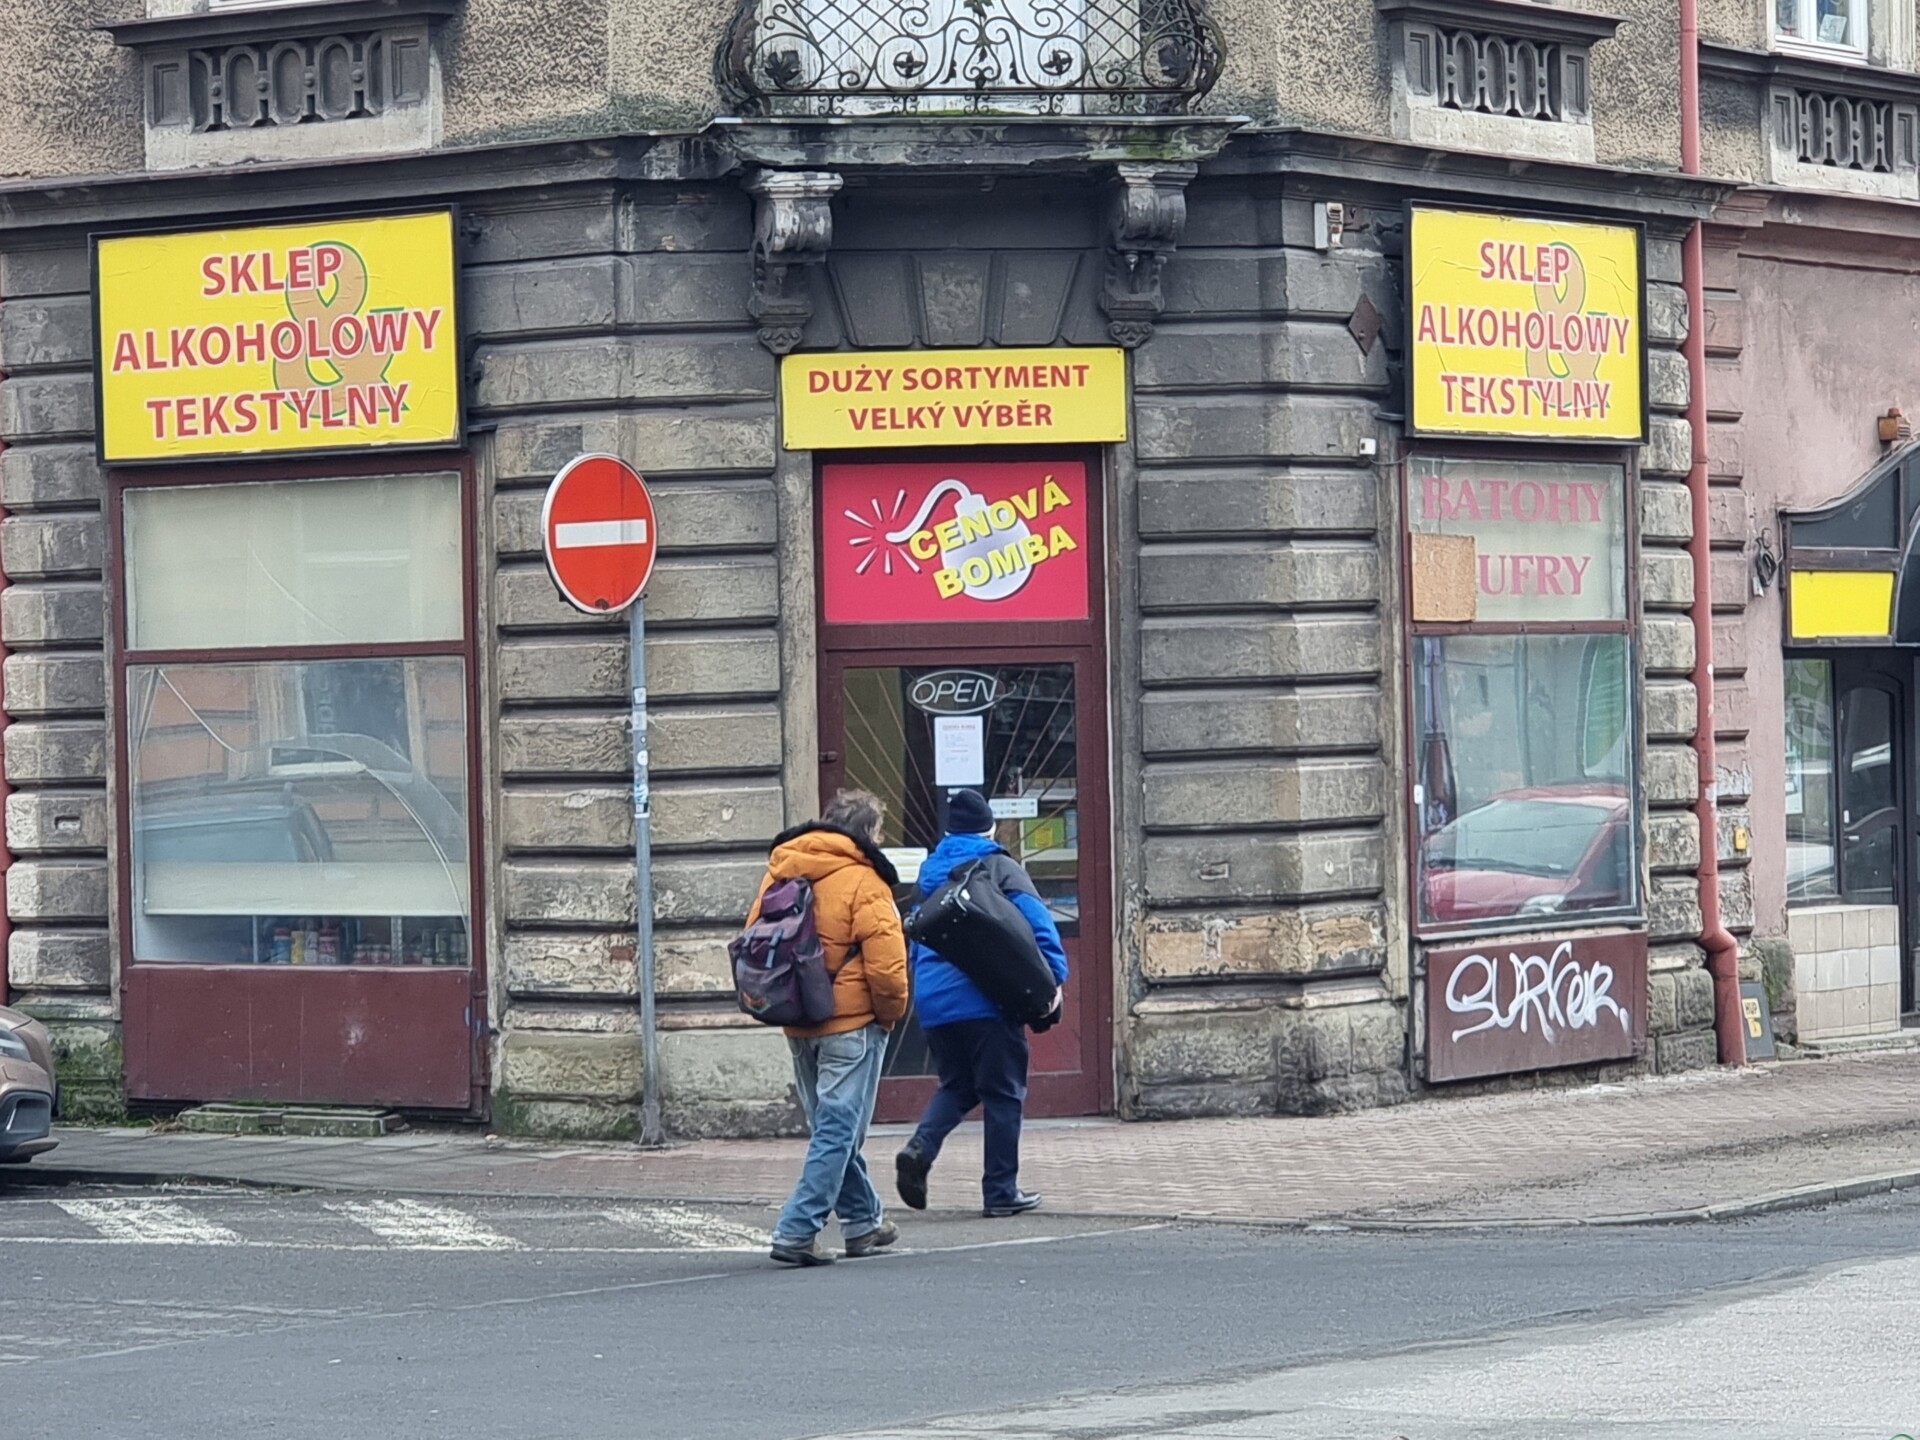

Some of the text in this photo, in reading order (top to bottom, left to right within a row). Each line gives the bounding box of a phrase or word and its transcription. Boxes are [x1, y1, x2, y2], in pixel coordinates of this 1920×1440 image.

[202, 247, 344, 296] SKLEP
[1478, 240, 1571, 285] SKLEP
[112, 308, 443, 373] ALKOHOLOWY
[1417, 303, 1631, 356] ALKOHOLOWY
[808, 363, 1090, 394] DUŻY SORTYMENT
[1440, 374, 1612, 420] TEKSTYLNY
[146, 382, 411, 439] TEKSTYLNY
[847, 399, 1054, 431] VELKÝ VÝBĚR
[908, 474, 1072, 561] CENOVÁ
[1421, 475, 1609, 525] BATOHY
[932, 524, 1079, 601] BOMBA
[1477, 554, 1592, 598] UFRY
[911, 678, 998, 705] OPEN
